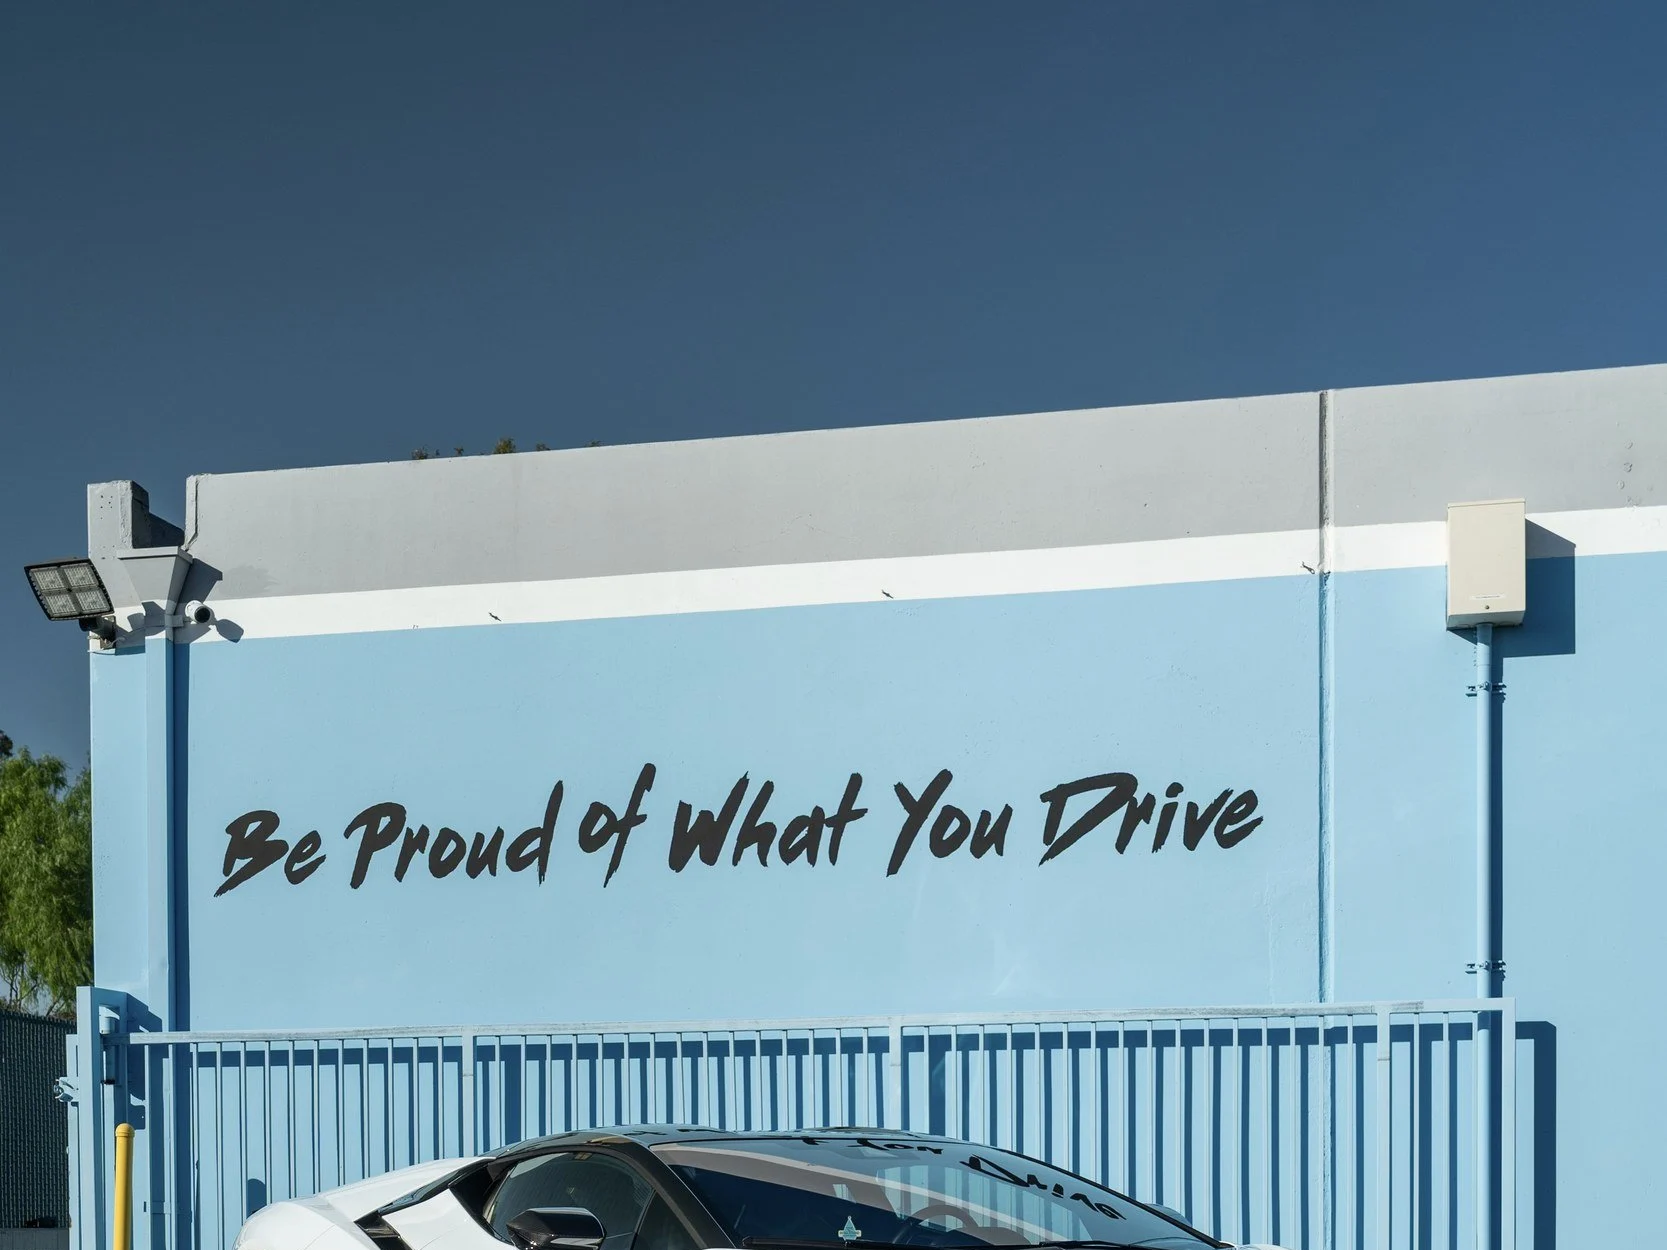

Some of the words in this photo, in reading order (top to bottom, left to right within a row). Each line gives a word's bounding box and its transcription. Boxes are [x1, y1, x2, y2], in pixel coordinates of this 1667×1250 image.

[214, 810, 326, 897] Be
[344, 780, 563, 889] Proud
[579, 763, 656, 888] of
[669, 771, 868, 873] What
[886, 769, 1013, 877] You
[1039, 773, 1263, 866] Drive
